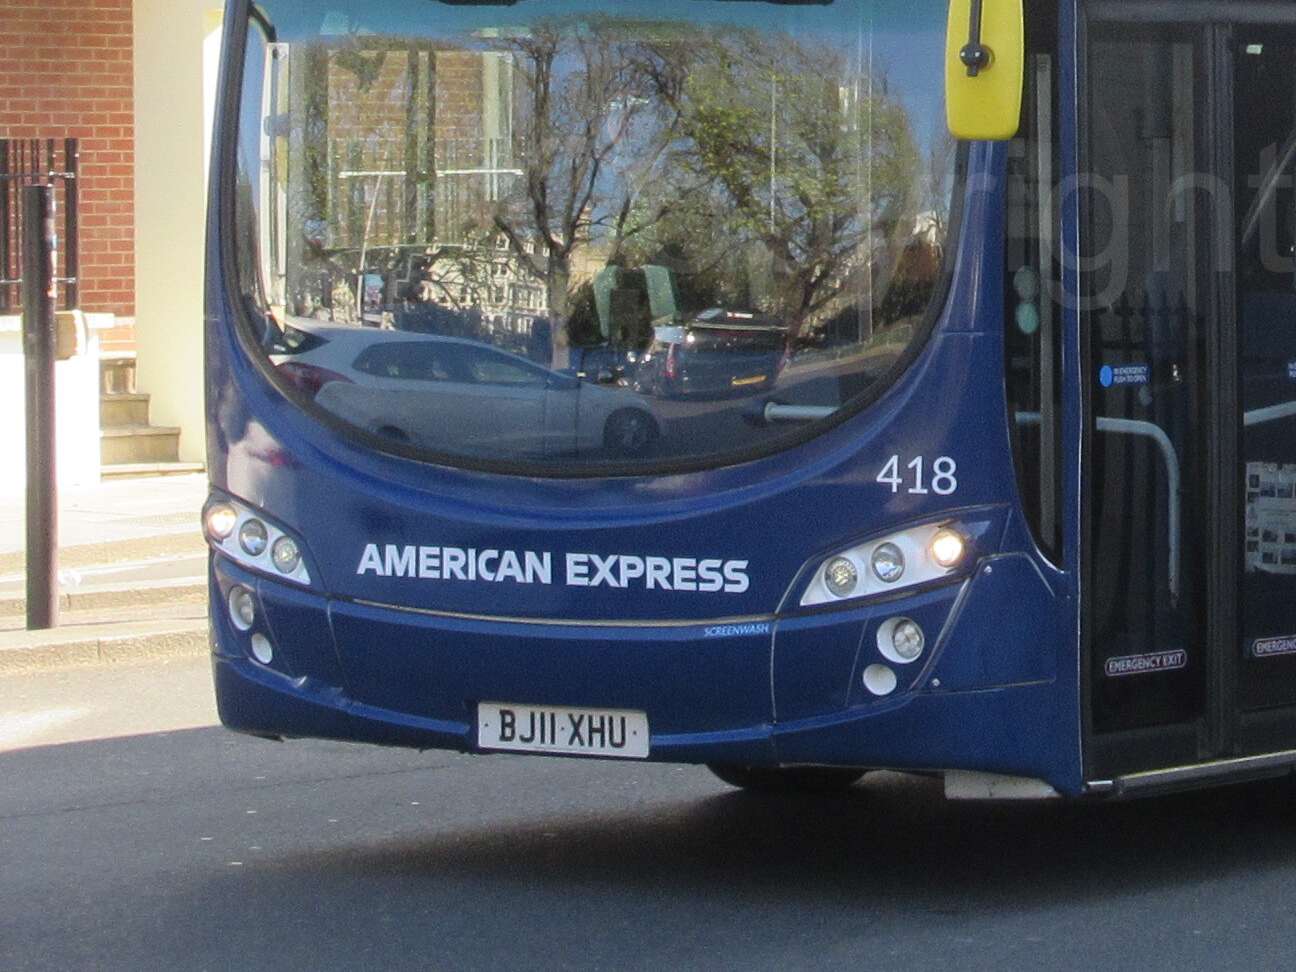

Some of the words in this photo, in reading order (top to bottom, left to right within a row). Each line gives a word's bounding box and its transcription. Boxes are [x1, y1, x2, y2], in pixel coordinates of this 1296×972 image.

[877, 455, 958, 496] 418
[357, 543, 552, 585] AMERICAN
[566, 552, 750, 594] EXPRESS
[703, 624, 770, 637] SCREENWASH
[1109, 656, 1161, 673] EMERGENCY
[1163, 653, 1183, 666] EXIT
[499, 709, 556, 745] BJ11
[568, 713, 626, 749] XHU
